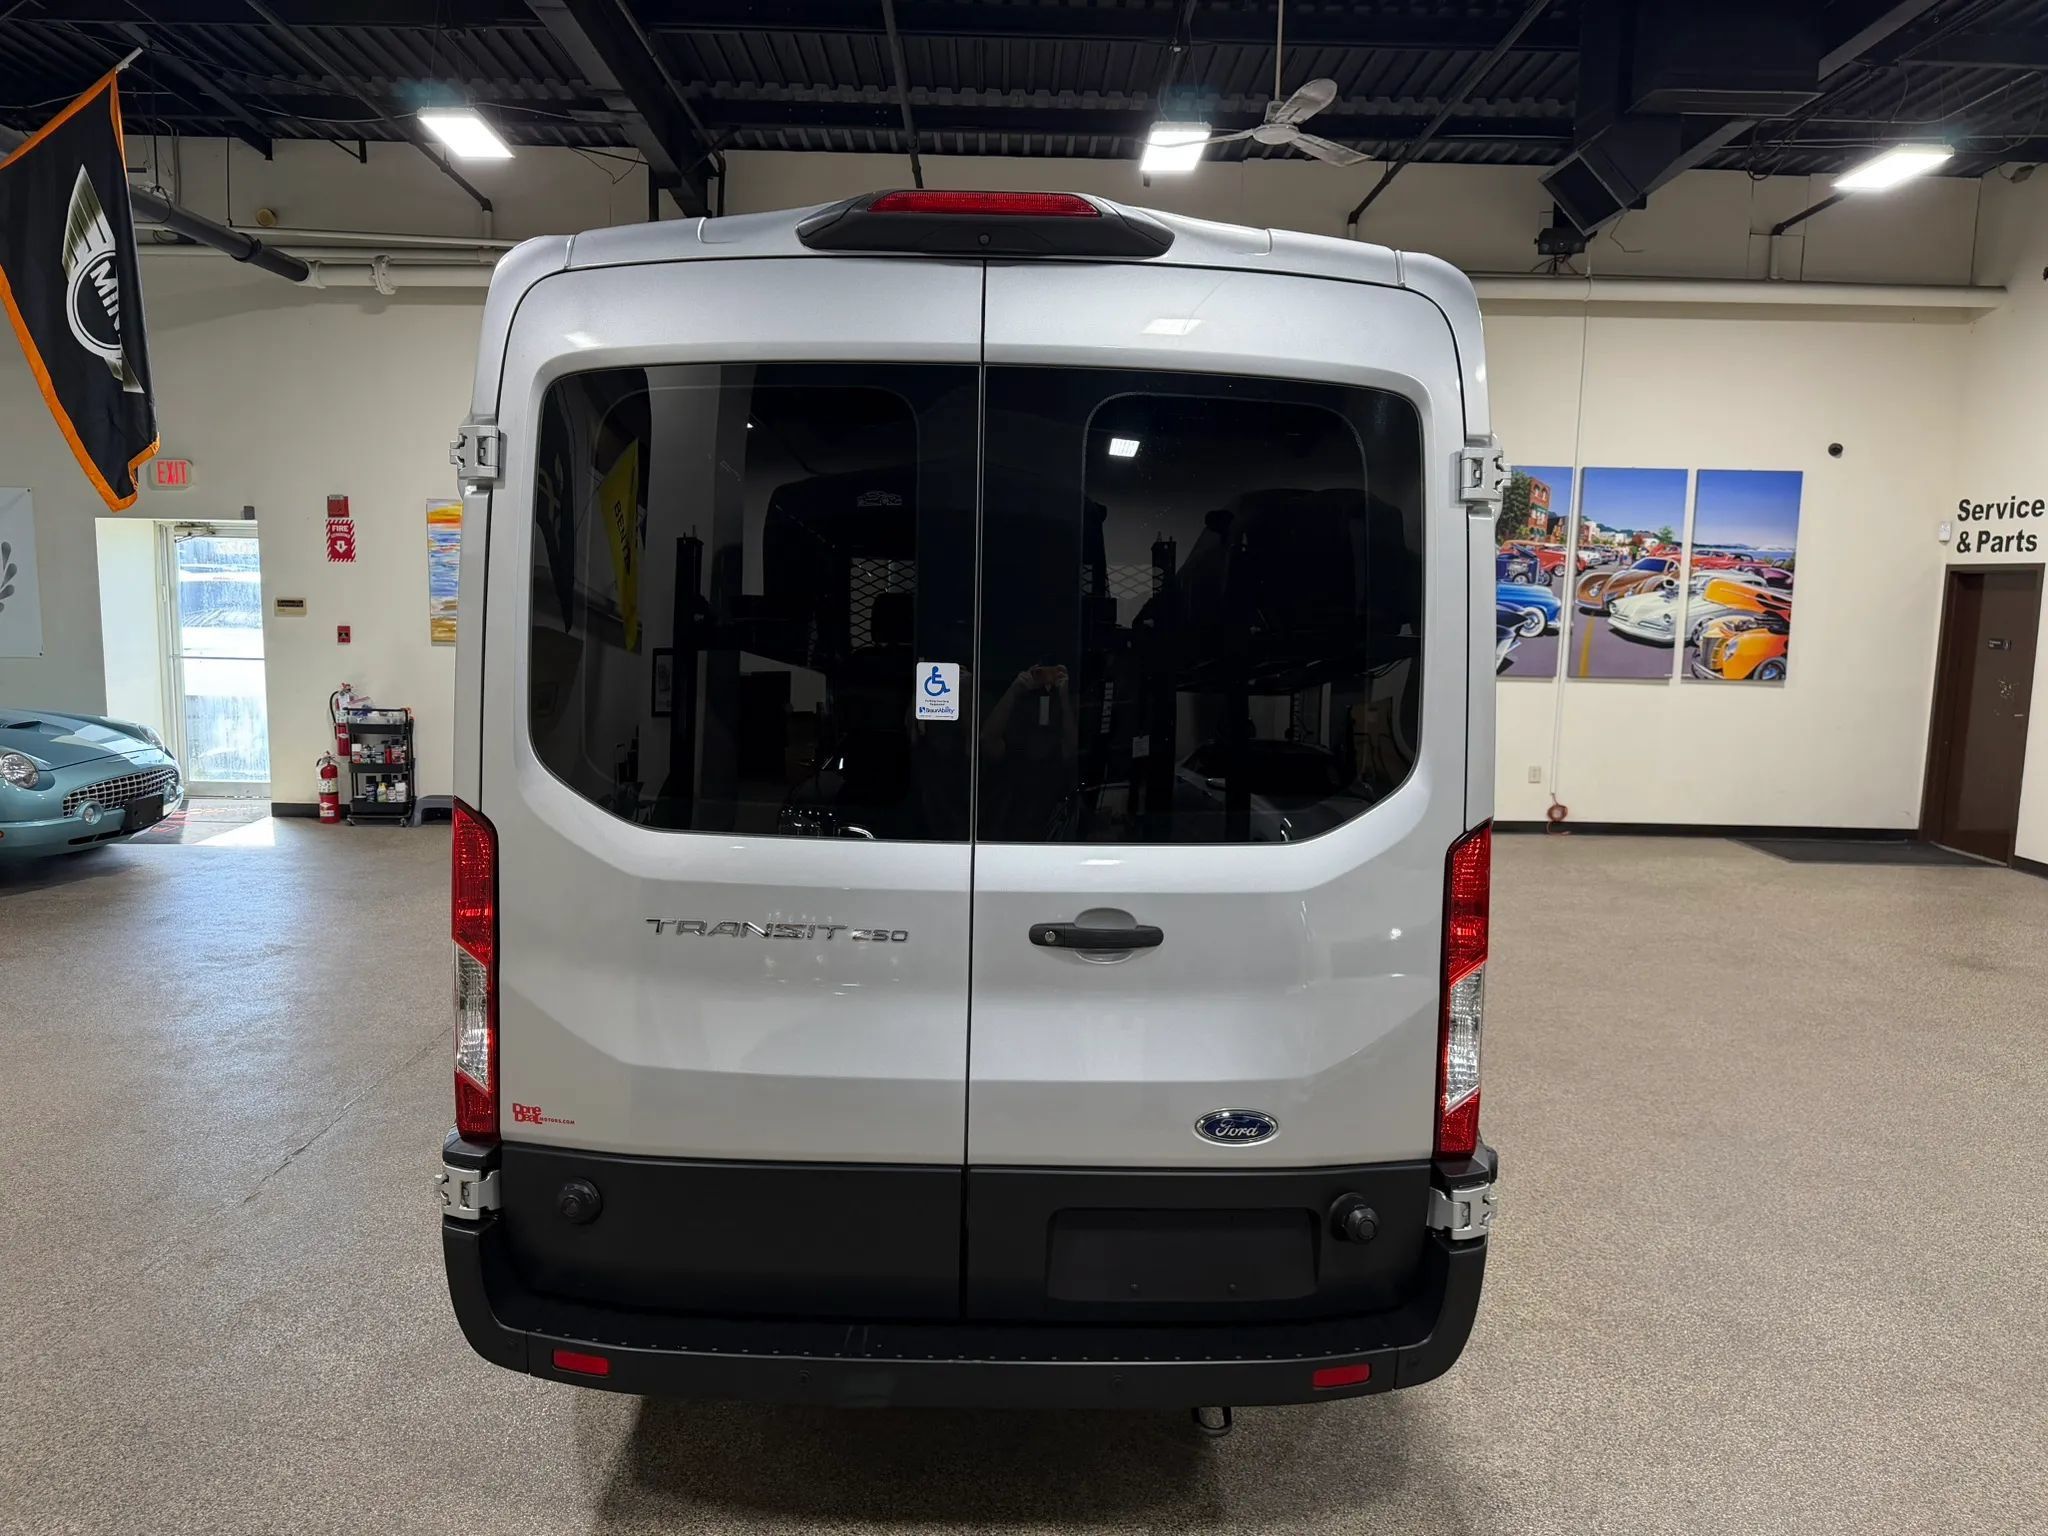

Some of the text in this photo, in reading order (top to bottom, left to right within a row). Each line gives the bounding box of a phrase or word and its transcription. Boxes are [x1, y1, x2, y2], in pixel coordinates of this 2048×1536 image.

[157, 460, 187, 484] EXIT
[1957, 495, 2045, 521] Service
[331, 524, 349, 532] FIRE
[1956, 529, 2038, 553] & Parts
[646, 918, 909, 942] TRANSIT 250
[1215, 1119, 1260, 1136] Ford
